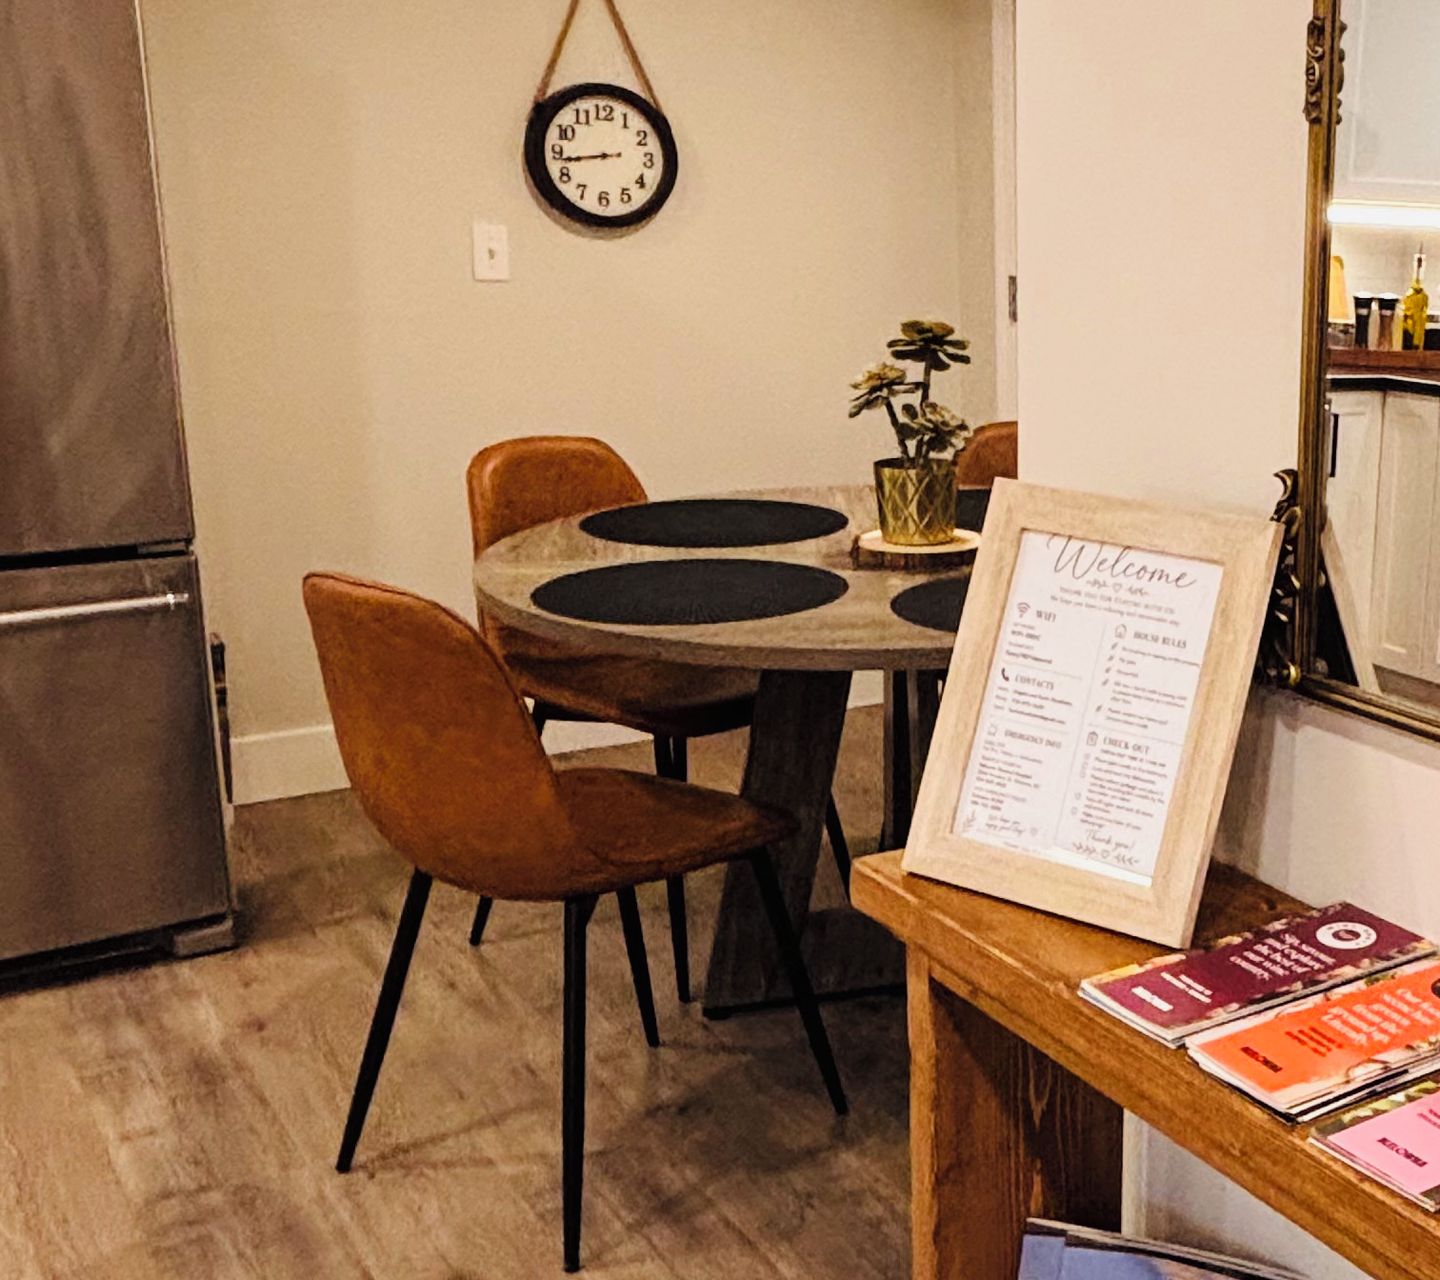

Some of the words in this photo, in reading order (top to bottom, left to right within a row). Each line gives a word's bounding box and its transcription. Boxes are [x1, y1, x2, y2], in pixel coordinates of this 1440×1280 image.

[574, 108, 591, 126] 11
[594, 104, 614, 121] 12
[621, 113, 629, 128] 1
[557, 124, 575, 141] 10
[637, 130, 647, 146] 2
[551, 144, 563, 160] 9
[644, 153, 654, 168] 3
[559, 166, 571, 184] 8
[635, 173, 645, 189] 4
[576, 184, 587, 200] 7
[598, 191, 610, 207] 6
[620, 188, 631, 203] 5
[1047, 533, 1198, 590] Welcome
